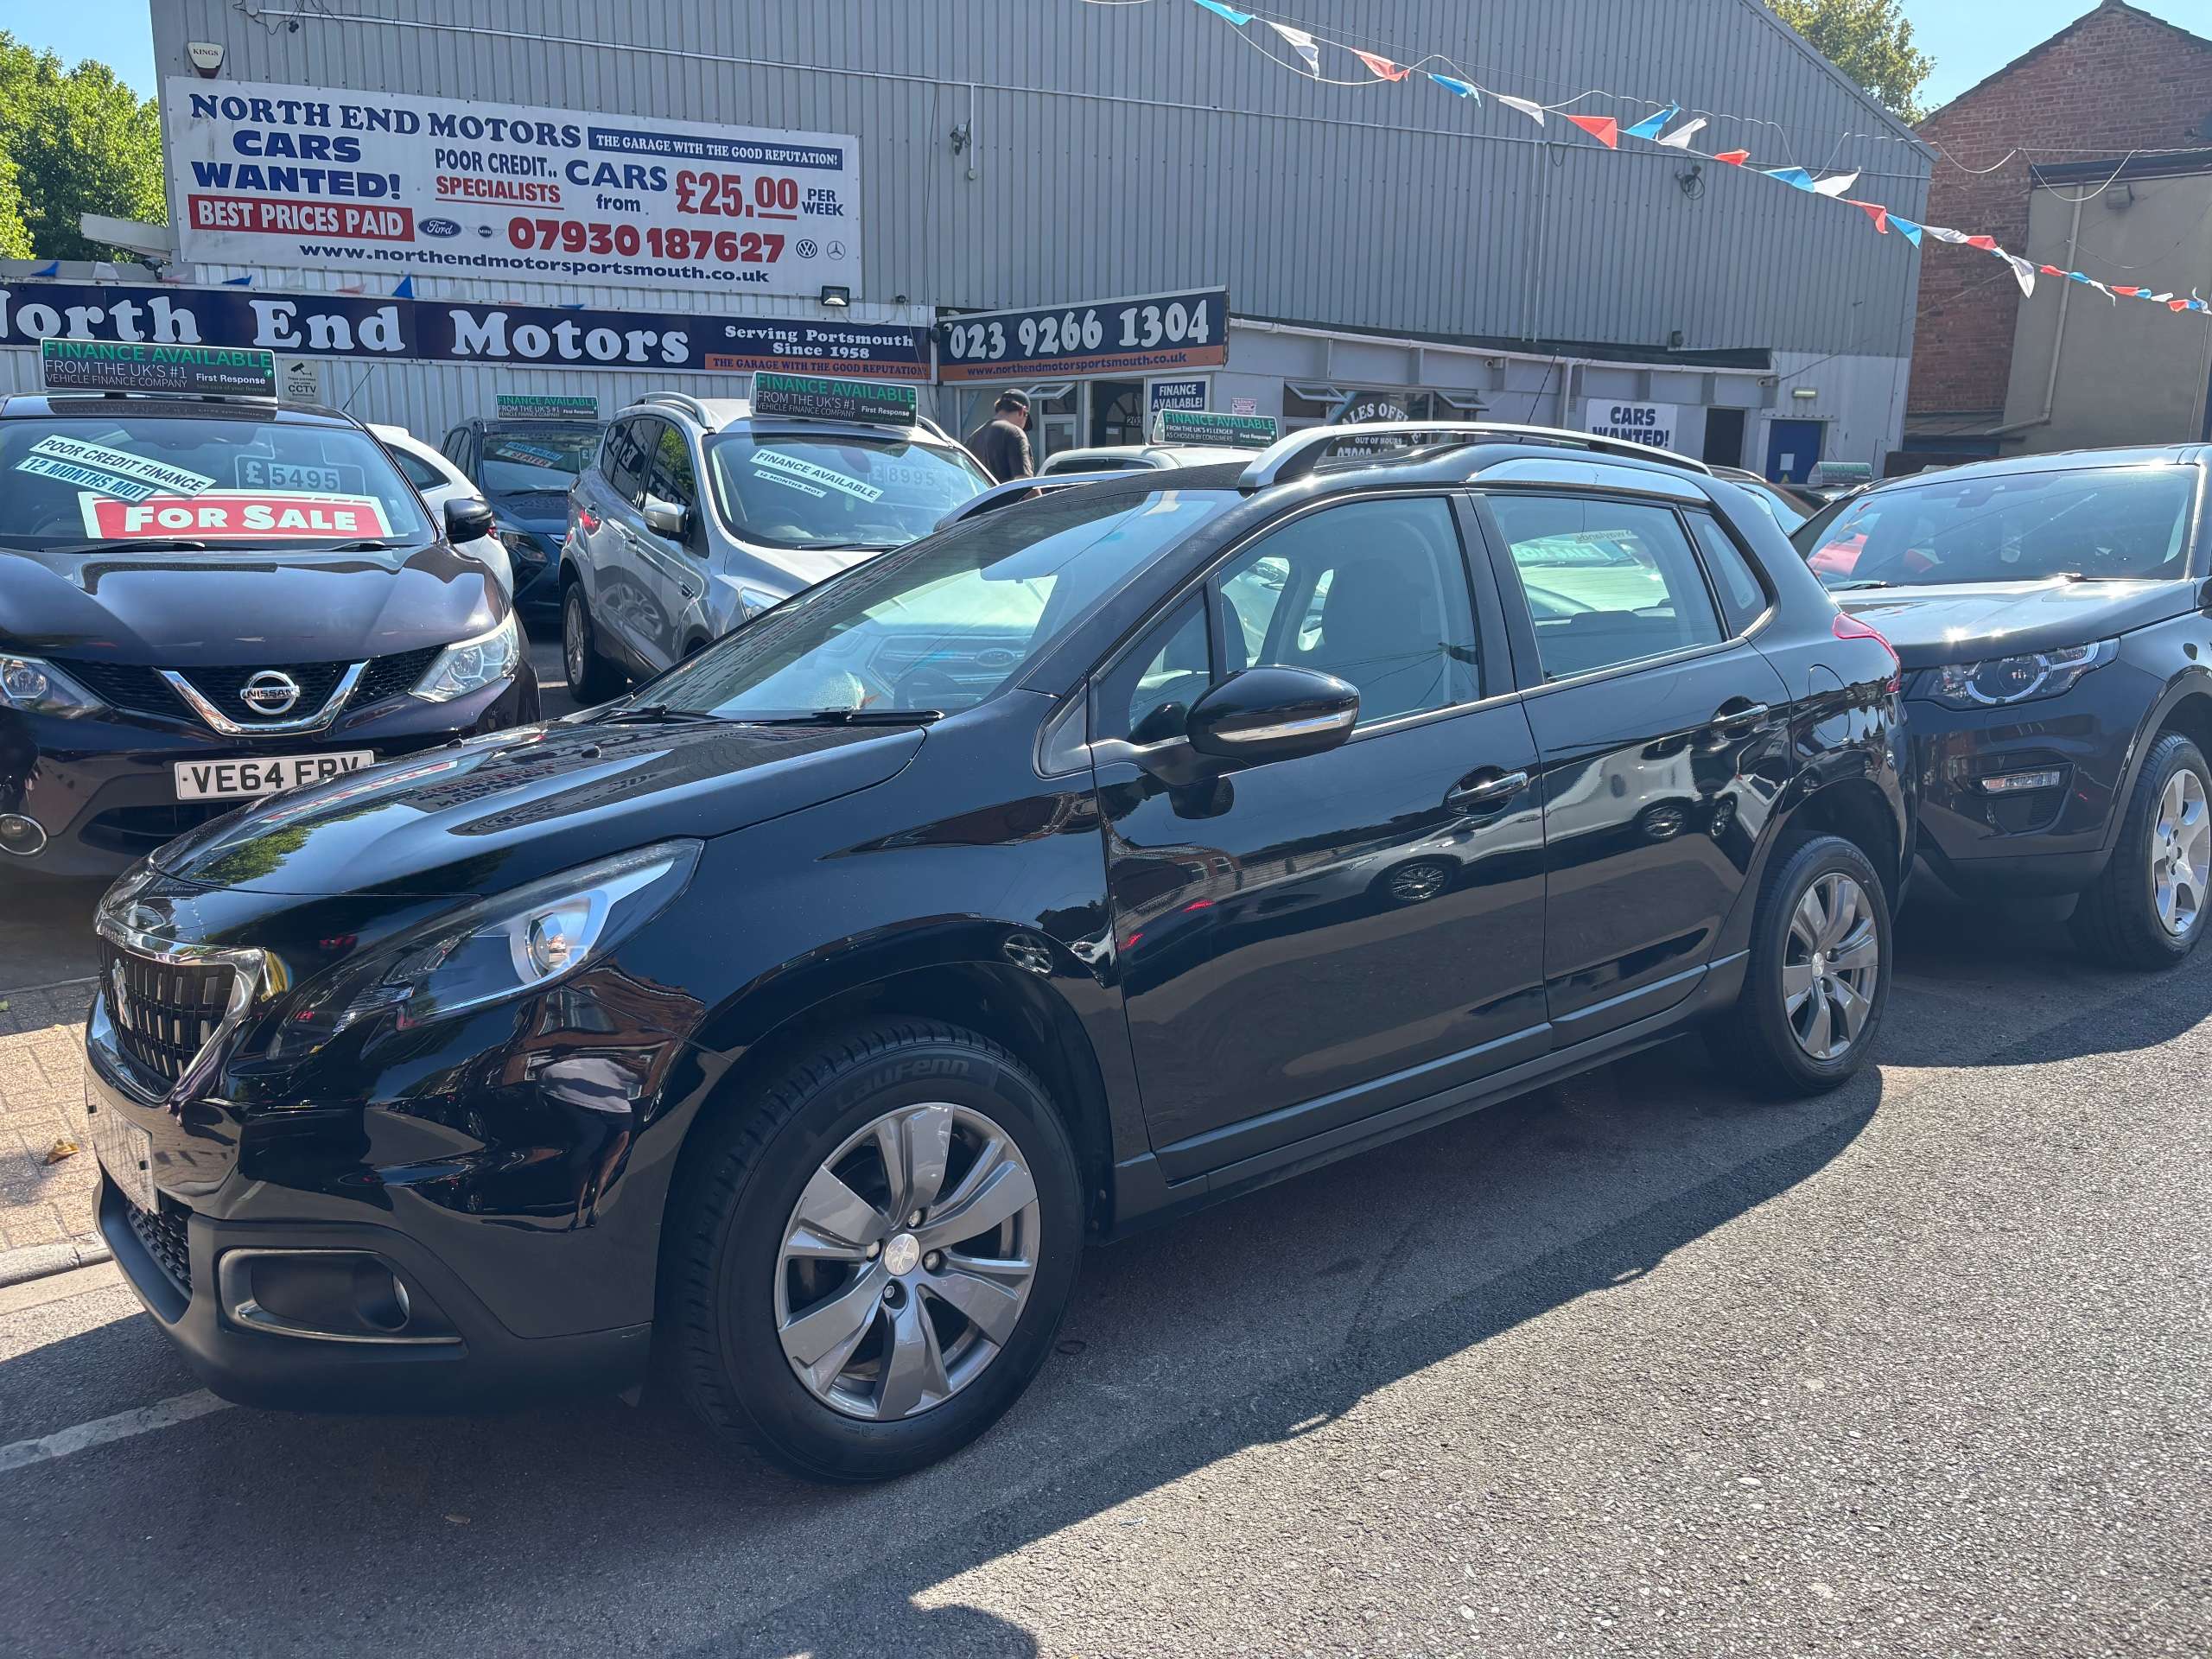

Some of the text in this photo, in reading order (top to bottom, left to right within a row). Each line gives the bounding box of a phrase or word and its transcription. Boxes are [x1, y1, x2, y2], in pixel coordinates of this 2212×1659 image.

[193, 47, 219, 57] KINGS
[188, 93, 582, 148] NORTH END MOTORS
[233, 130, 361, 162] CARS
[596, 135, 838, 165] THE GARAGE WITH THE GOOD REPUTATION!
[435, 148, 484, 172] POOR
[191, 161, 400, 200] WANTED!
[565, 159, 668, 192] CARS
[437, 175, 561, 203] SPECIALISTS
[676, 170, 798, 218] £25.00
[807, 188, 836, 203] PER
[596, 194, 641, 213] from
[802, 201, 844, 217] WEEK
[199, 200, 404, 237] BEST PRICES PAID
[427, 219, 454, 235] Ford
[508, 217, 785, 264] 07930 187627
[299, 245, 769, 283] www.northendmotorsportsmouth.co.uk
[249, 299, 406, 352] End
[448, 309, 690, 363] Motors
[725, 326, 914, 346] Serving Portsmouth
[950, 300, 1209, 359] 023 9266 1304
[44, 342, 273, 369] FINANCE AVAILABLE
[772, 342, 870, 359] Since 1958
[45, 359, 188, 378] FROM THE UK'S #1
[713, 358, 734, 367] THE
[736, 359, 779, 370] GARAGE
[781, 361, 808, 372] WITH
[810, 363, 830, 372] THE
[833, 364, 861, 372] GOOD
[967, 352, 1187, 376] www.northendmotorsportsmouth.co.uk
[47, 373, 188, 388] VEHICLE FINANCE COMPANY
[196, 373, 266, 385] First Response
[288, 385, 316, 393] CCTV
[757, 375, 916, 403] FINANCE AVAILABLE
[758, 391, 855, 410] FROM THE UK'S #1
[1159, 385, 1197, 396] FINANCE
[498, 397, 596, 407] FINANCE AVAILABLE
[757, 403, 856, 418] VEHICLE FINANCE COMPANY
[861, 405, 910, 417] First Response
[1153, 397, 1204, 410] AVAILABLE!
[1166, 413, 1215, 425] FINANCE
[1217, 416, 1275, 429] AVAILABLE
[1342, 403, 1375, 424] ALES
[1610, 406, 1656, 426] CARS
[39, 440, 207, 492] POOR CREDIT FINANCE
[757, 453, 878, 499] FINANCE AVAILABLE
[24, 458, 149, 499] 12 MONTHS MOT
[770, 474, 803, 489] MONTHS
[124, 505, 358, 532] FOR SALE
[247, 690, 296, 699] NISSAN
[191, 762, 284, 793] VE64
